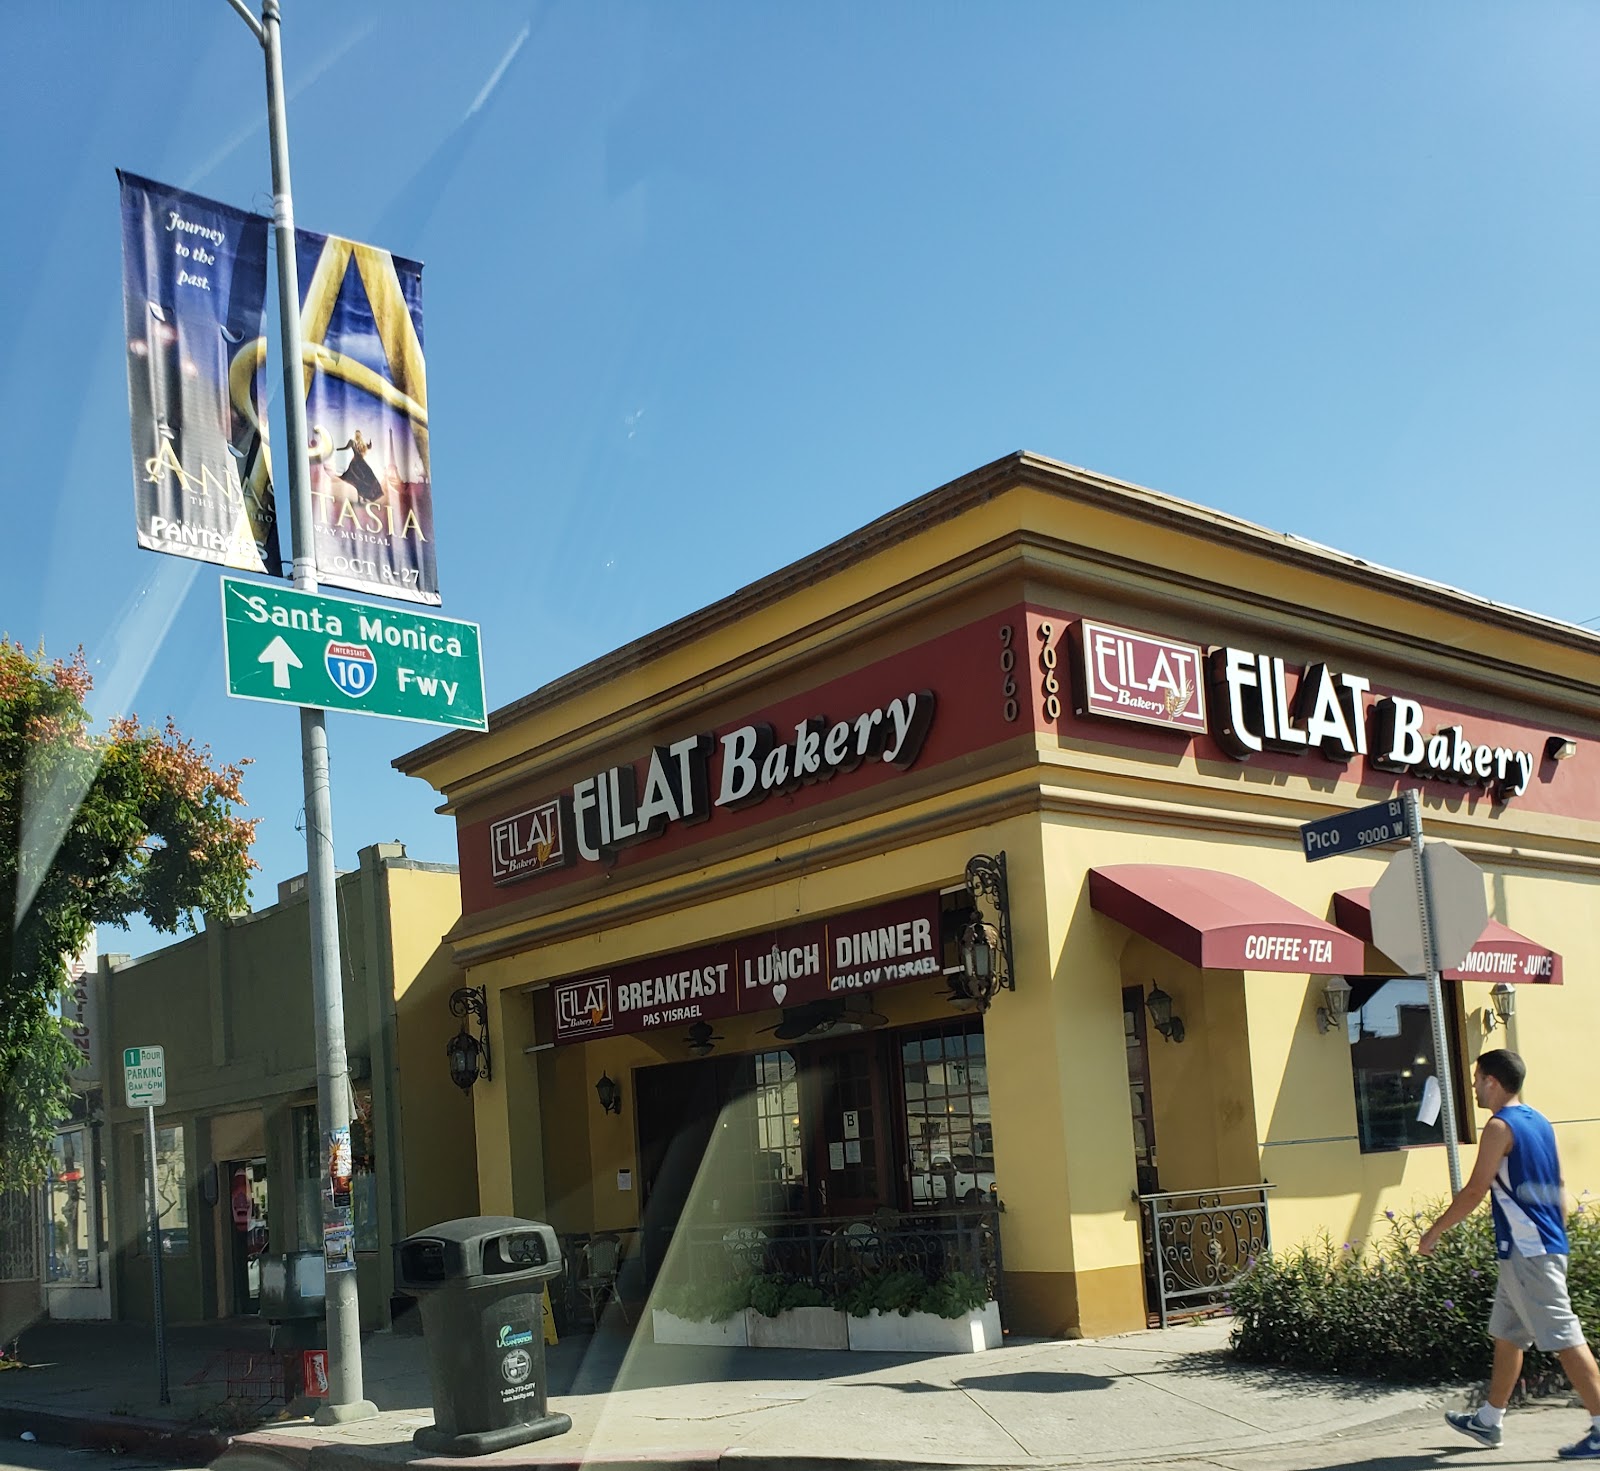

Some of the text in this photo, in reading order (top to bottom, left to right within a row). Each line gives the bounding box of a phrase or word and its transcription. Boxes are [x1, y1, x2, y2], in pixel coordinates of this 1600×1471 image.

[164, 210, 226, 247] Journey
[175, 241, 215, 266] to the
[176, 269, 211, 291] past.
[189, 496, 215, 510] THE
[313, 524, 391, 547] WAY MUSICAL
[333, 555, 376, 577] OCT
[248, 595, 463, 658] Santa Monica
[333, 646, 367, 659] INTERSTATE
[337, 661, 366, 690] 10
[1000, 624, 1018, 723] 9060
[1041, 620, 1062, 719] 9060
[398, 667, 459, 706] Fwy
[1116, 688, 1165, 716] Bakery
[714, 692, 917, 808] Bakery
[1389, 695, 1534, 797] Bakery
[1357, 824, 1389, 846] 9000
[1392, 821, 1403, 836] W
[508, 856, 538, 873] Bakery
[1245, 934, 1333, 964] COFFEE TEA
[617, 918, 933, 1013] BREAKFAST LUNCH DINNER
[830, 956, 940, 992] CHOLOV YISRAEL
[1523, 954, 1553, 976] JUICE
[642, 1004, 703, 1027] PAS YISRAEL
[129, 1051, 136, 1065] 1
[127, 1066, 162, 1080] PARKING
[147, 1080, 163, 1090] 6PM
[847, 1113, 855, 1127] B
